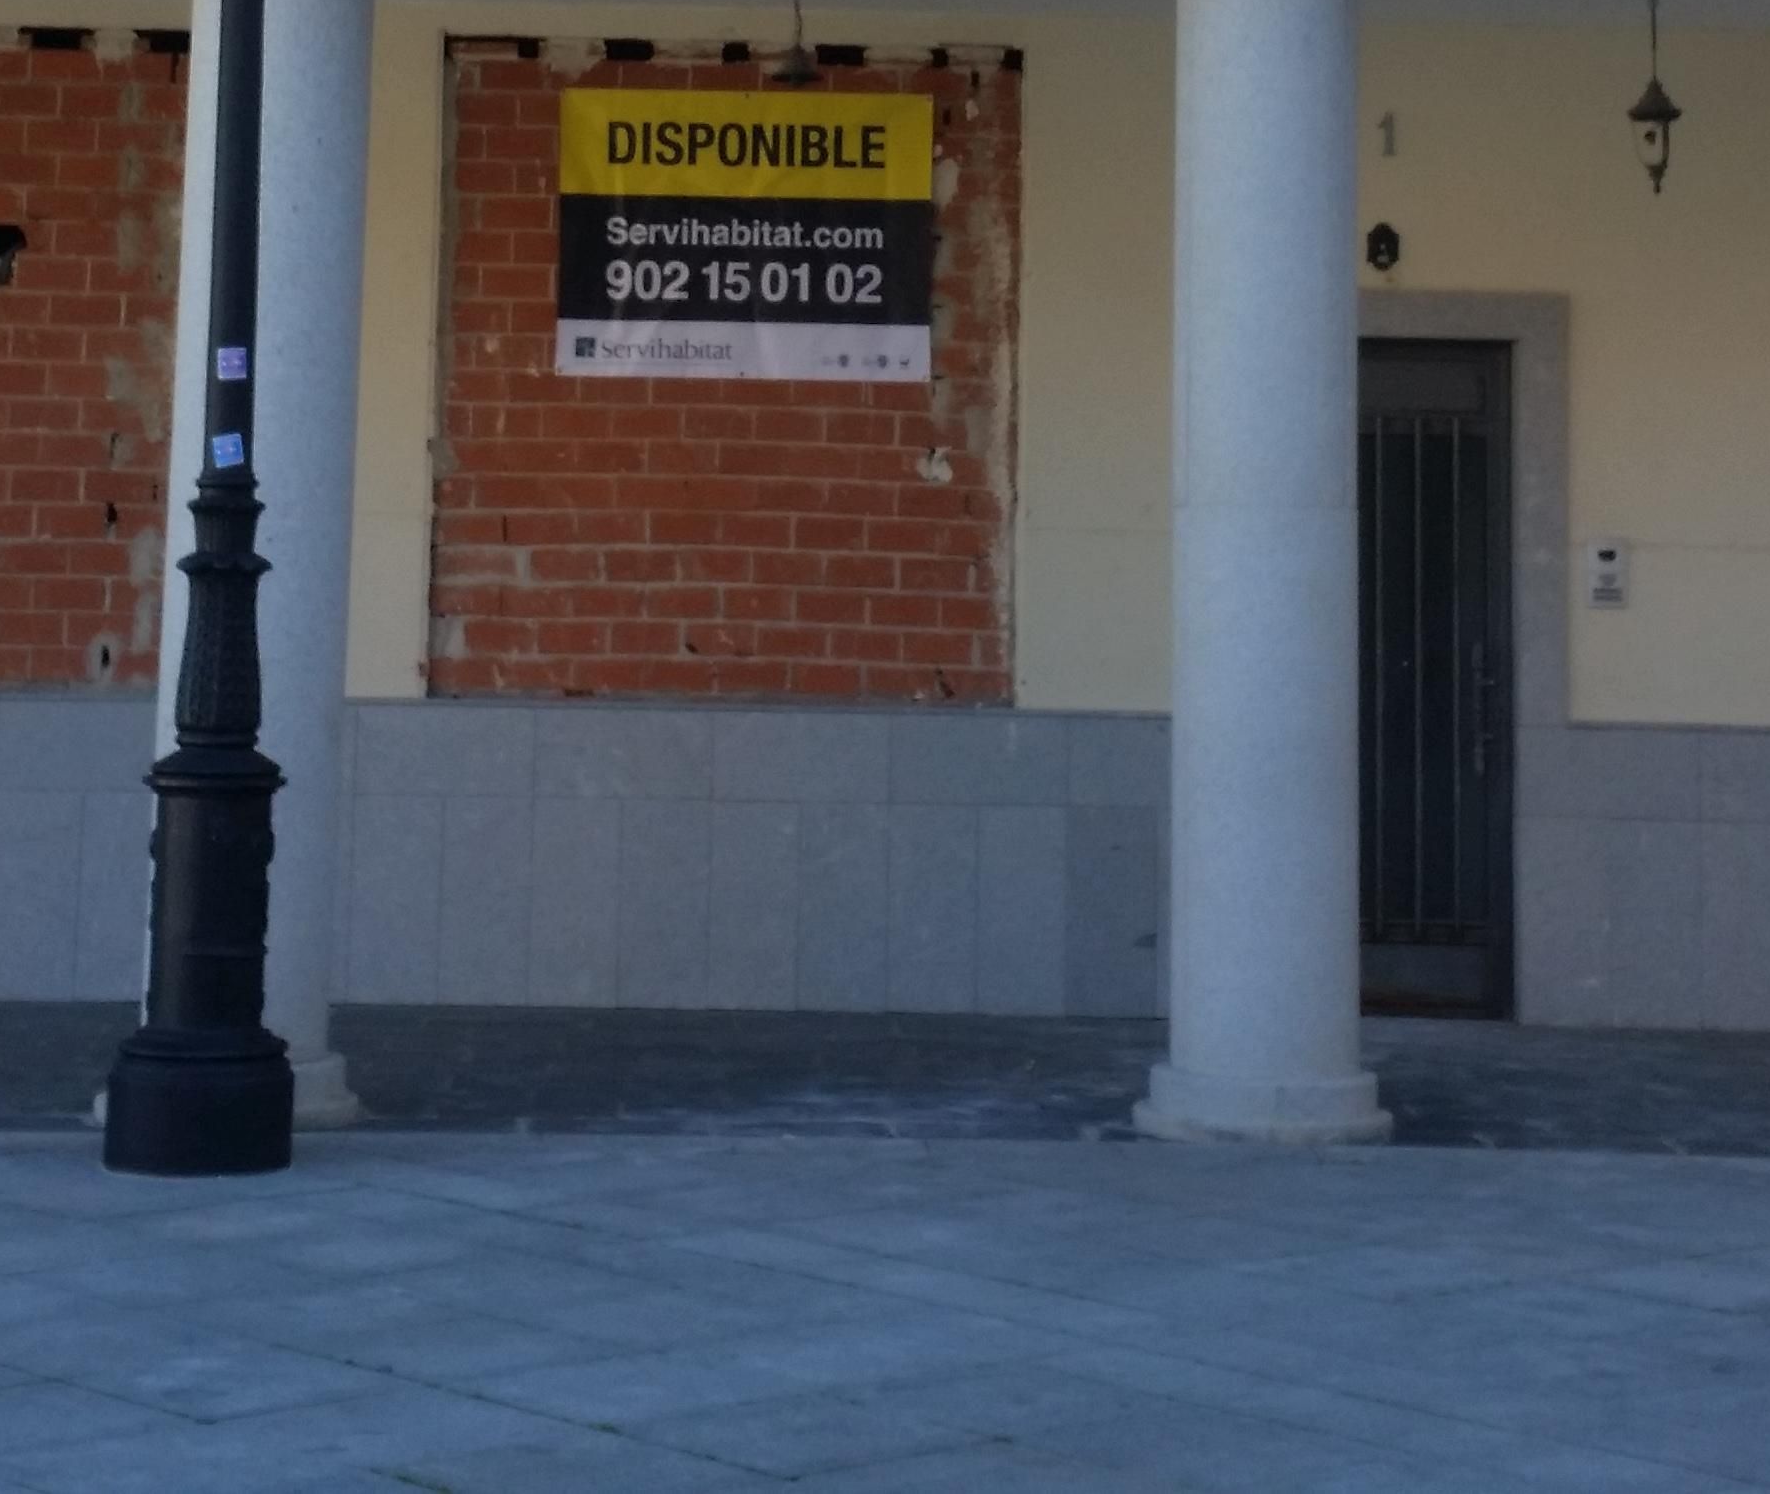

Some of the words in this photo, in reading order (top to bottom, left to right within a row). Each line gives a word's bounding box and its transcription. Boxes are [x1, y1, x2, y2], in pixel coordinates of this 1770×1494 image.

[607, 121, 886, 169] DISPONIBLE
[1378, 112, 1395, 157] 1
[606, 216, 884, 249] Servihabitat.com
[605, 260, 690, 301] 902
[701, 262, 751, 302] 15
[760, 262, 812, 303] 01
[826, 263, 884, 304] 02
